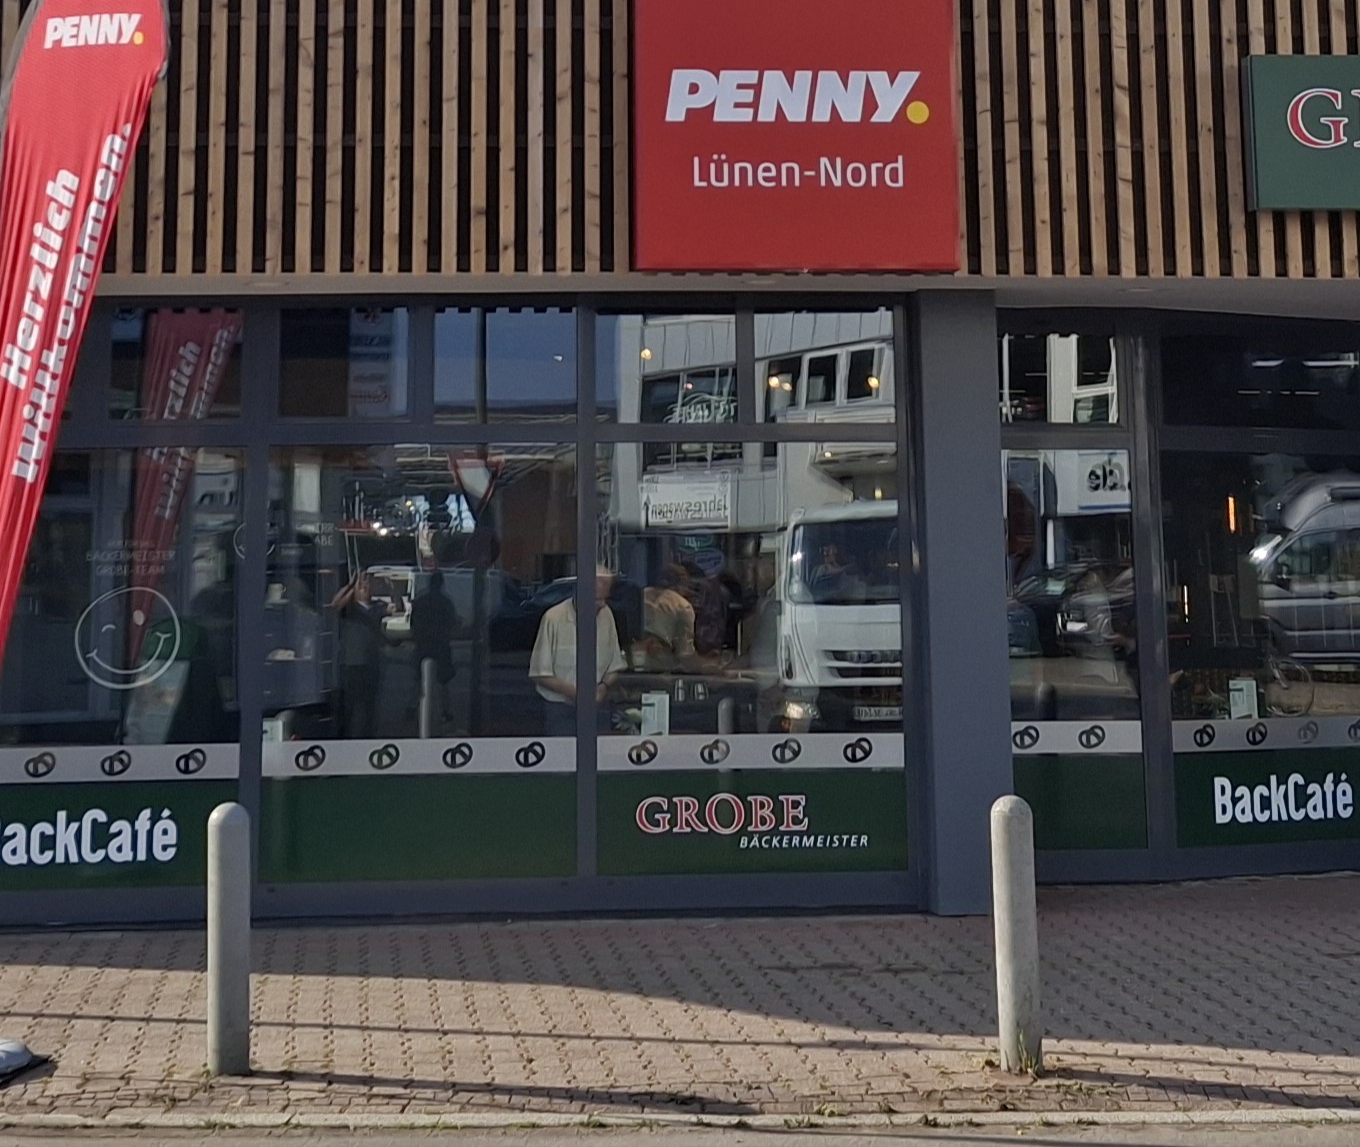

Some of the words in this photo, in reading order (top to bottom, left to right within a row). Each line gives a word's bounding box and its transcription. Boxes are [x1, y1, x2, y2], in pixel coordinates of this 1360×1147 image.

[693, 153, 904, 188] Lünen-Nord
[0, 168, 80, 392] Herzlich
[636, 793, 808, 834] GROBE
[1214, 772, 1354, 825] BackCafé
[740, 834, 869, 849] BÄCKERMEISTER
